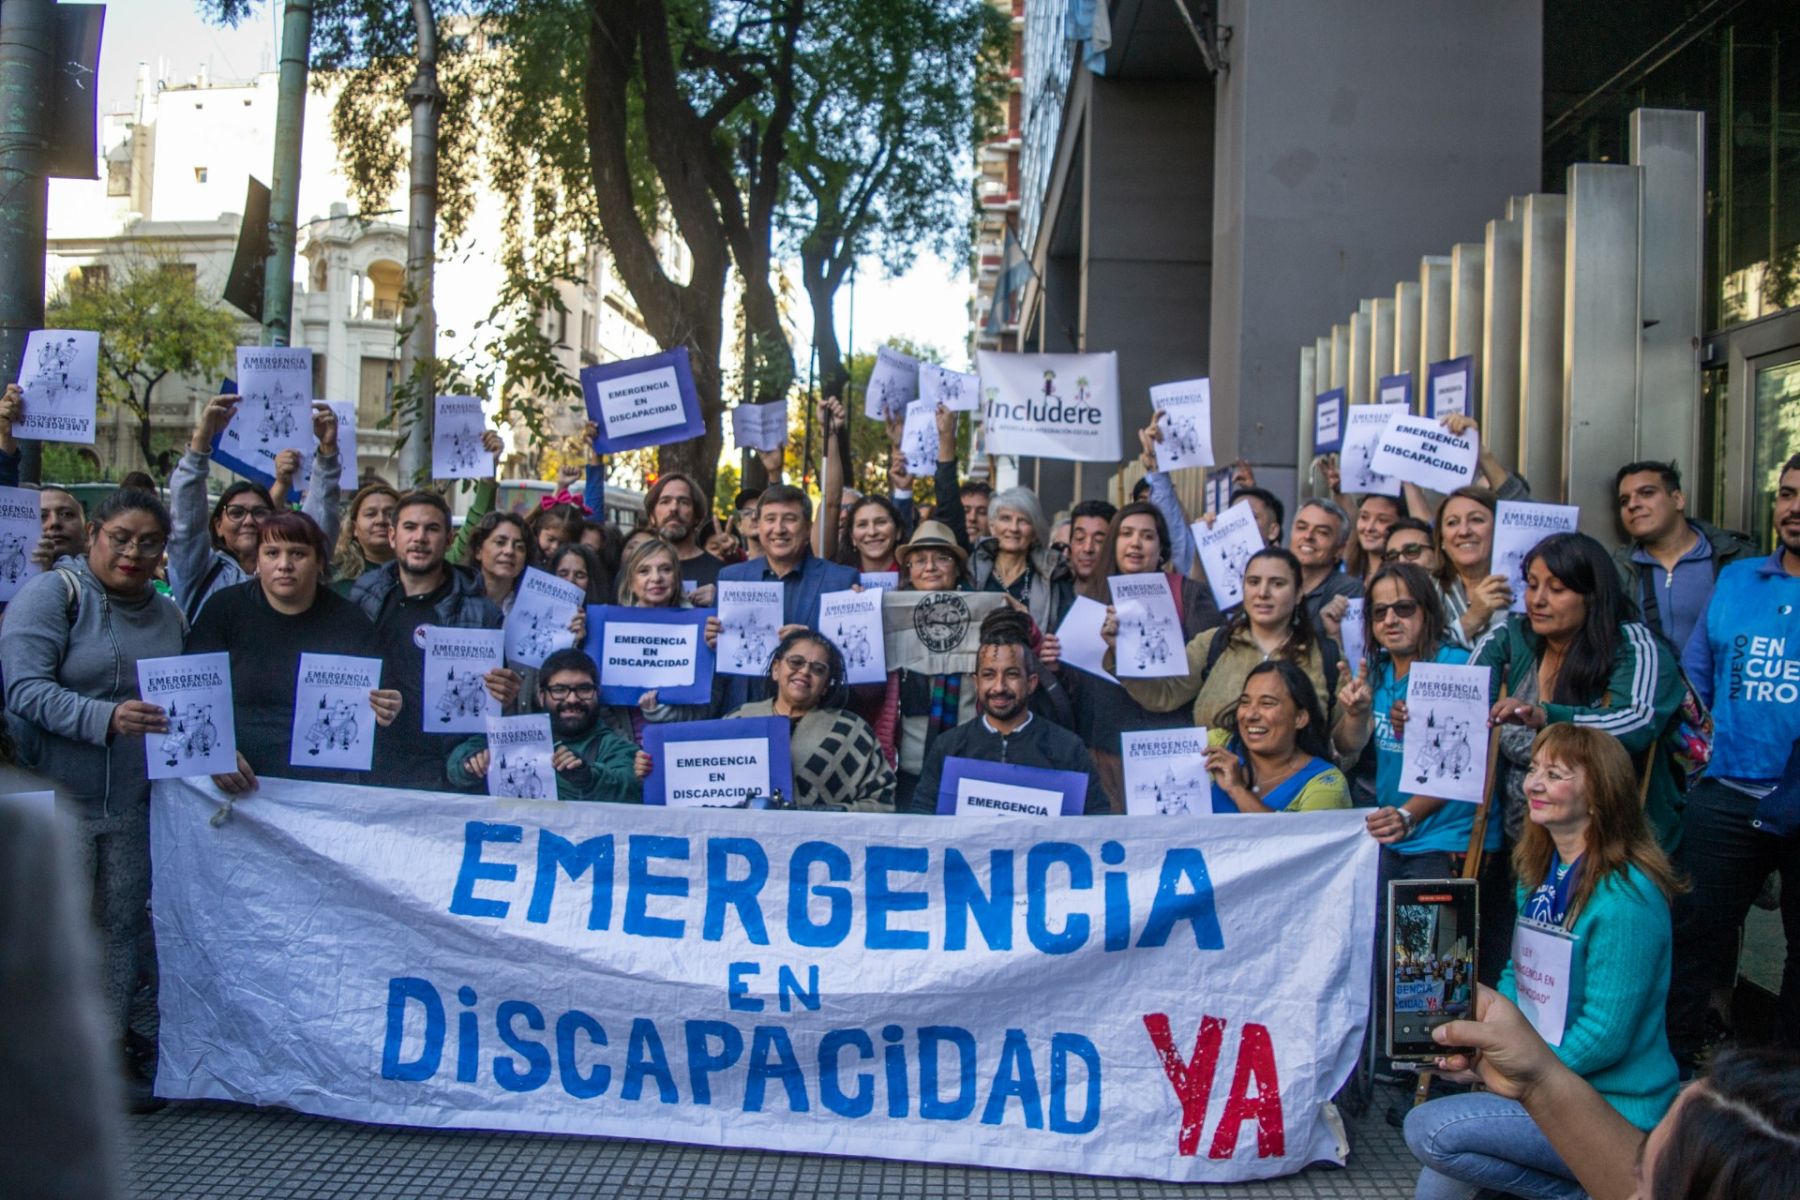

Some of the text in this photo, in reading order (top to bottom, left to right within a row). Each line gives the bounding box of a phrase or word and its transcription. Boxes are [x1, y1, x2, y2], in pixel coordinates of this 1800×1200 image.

[244, 356, 305, 365] EMERGENCIA
[608, 381, 670, 399] EMERGENCIA
[634, 398, 648, 406] EN
[609, 404, 678, 423] DISCAPACIDAD
[21, 419, 87, 432] EMERGENCIA
[1396, 424, 1471, 450] EMERGENCIA
[1421, 441, 1438, 453] EN
[1383, 444, 1468, 475] DISCAPACIDAD
[1504, 511, 1570, 524] EMERGENCIA
[529, 577, 580, 601] EMERGENCIA
[724, 590, 777, 598] EMERGENCIA
[1117, 584, 1164, 592] EMERGENCIA
[827, 601, 874, 612] EMERGENCIA
[614, 635, 687, 645] EMERGENCIA
[1749, 635, 1786, 657] EN
[434, 643, 495, 654] EMERGENCIA
[642, 648, 658, 656] EN
[608, 657, 690, 668] DISCAPACIDAD
[1728, 634, 1748, 700] NUEVO
[1745, 657, 1800, 681] CUE
[149, 672, 220, 687] EMERGENCIA
[307, 671, 369, 682] EMERGENCIA
[161, 679, 223, 690] DISCAPACIDAD
[316, 678, 371, 688] DISCAPACIDAD
[1413, 680, 1480, 693] EMERGENCIA
[1422, 689, 1482, 701] DISCAPACIDAD
[1742, 679, 1799, 704] TRO
[489, 729, 543, 740] MERGENCIA
[1130, 739, 1199, 751] EMERGENCIA
[676, 755, 757, 768] EMERGENCIA
[709, 773, 726, 782] EN
[673, 787, 763, 799] DISCAPACIDAD
[967, 796, 1049, 816] EMERGENCIA
[728, 961, 822, 1012] EN
[1142, 1012, 1286, 1160] YA
